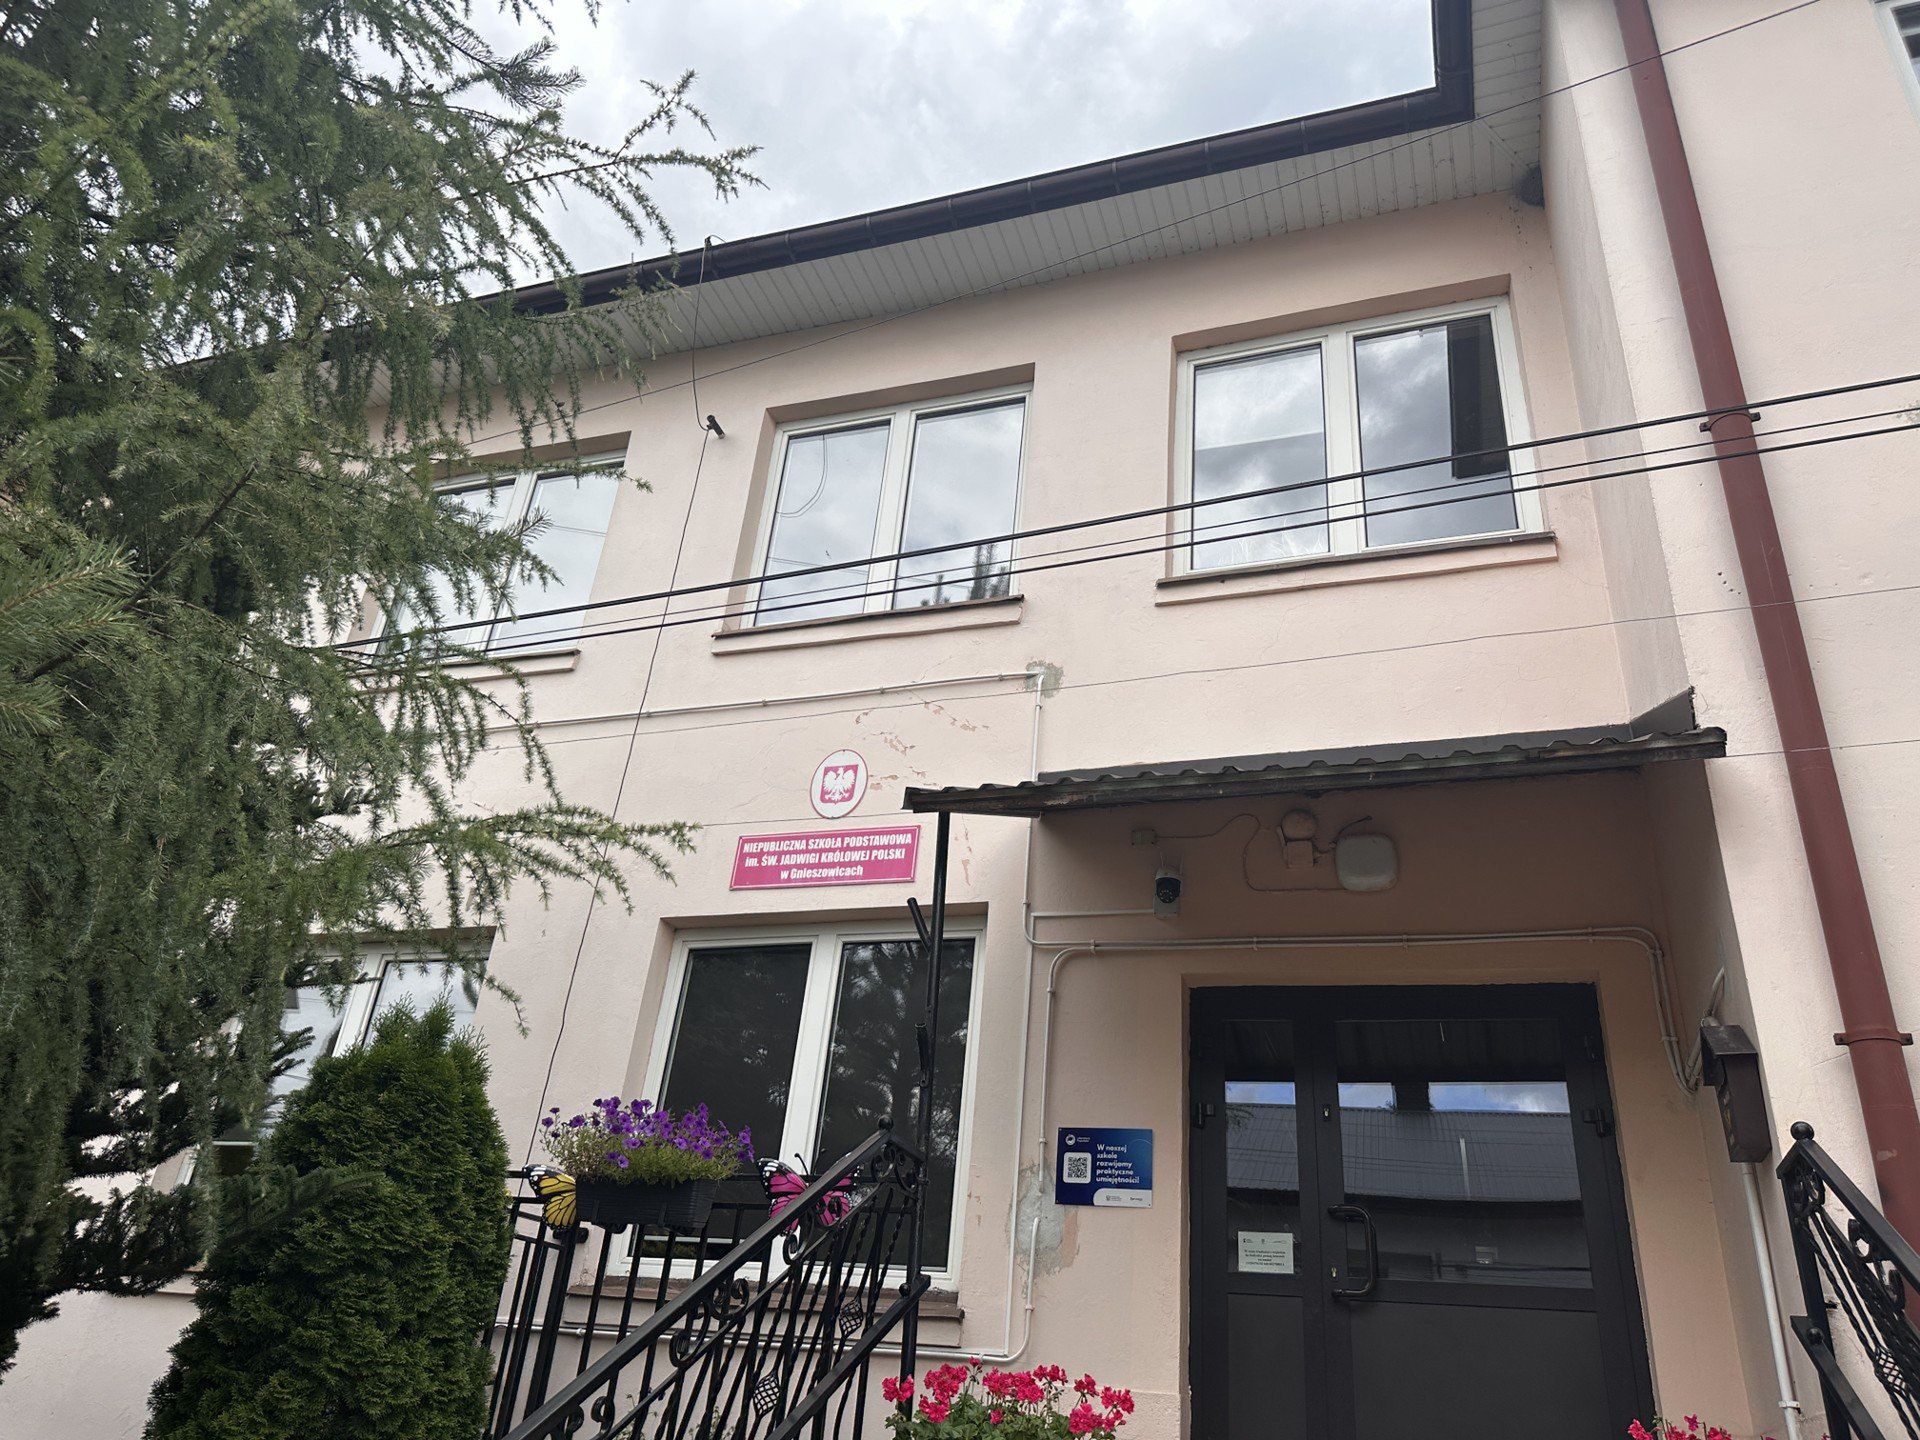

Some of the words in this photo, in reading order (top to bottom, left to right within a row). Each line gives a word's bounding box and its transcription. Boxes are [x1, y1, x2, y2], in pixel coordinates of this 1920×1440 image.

[743, 839, 806, 853] NIEPUBLICZNA
[808, 837, 842, 850] SZKOŁA
[843, 833, 912, 847] PODSTAWOWA
[744, 856, 760, 867] im.
[761, 853, 779, 867] ŚW.
[780, 852, 820, 865] JADWIGI
[820, 849, 870, 863] KRÓLOWEJ
[871, 848, 906, 860] POLSKI
[780, 870, 789, 879] w
[790, 865, 863, 879] Gnieszowicach
[1106, 1145, 1127, 1153] naszej
[1096, 1161, 1132, 1169] rozwijamy
[1096, 1168, 1134, 1176] praktyczne
[1096, 1176, 1139, 1184] umiejętności!
